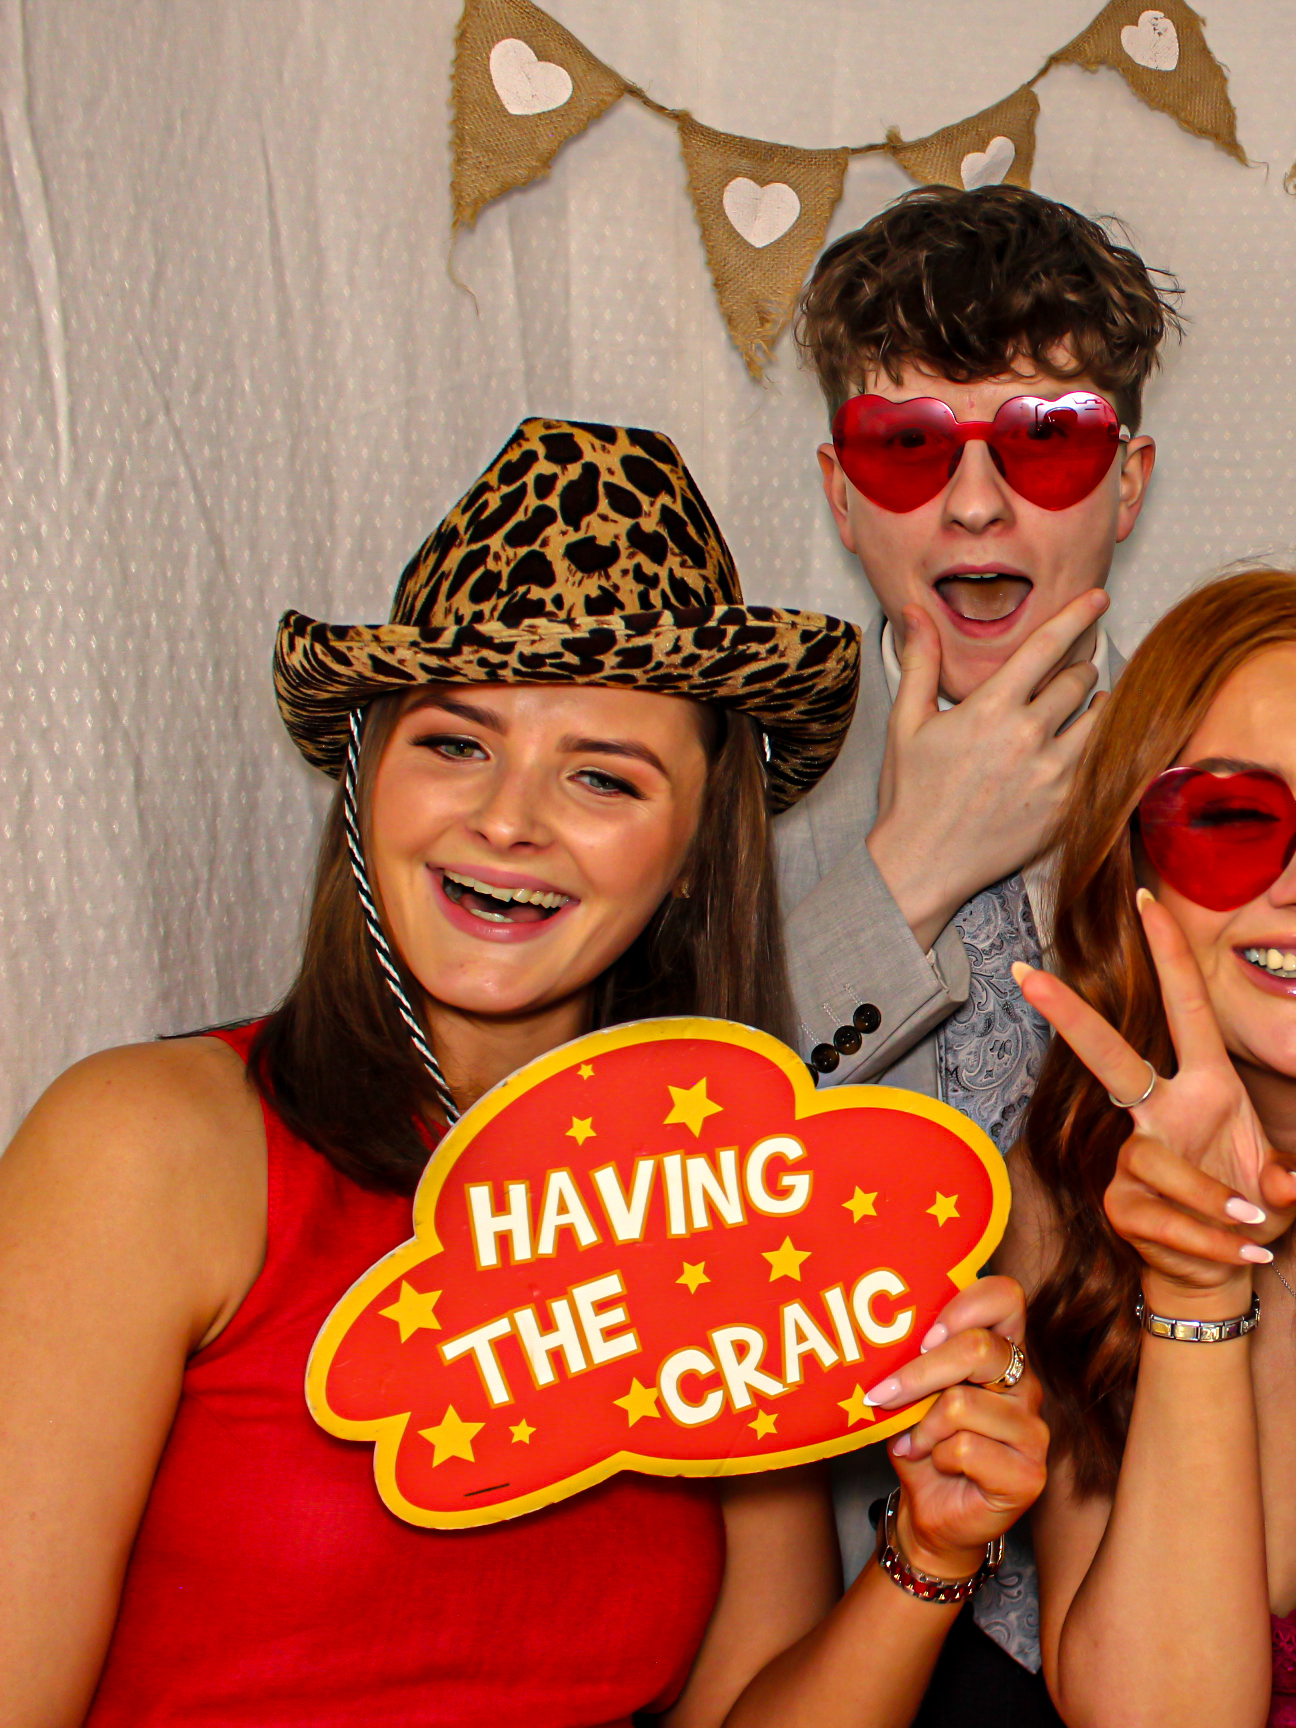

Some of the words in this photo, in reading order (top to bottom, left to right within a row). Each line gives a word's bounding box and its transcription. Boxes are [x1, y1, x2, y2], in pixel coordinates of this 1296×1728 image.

[467, 1136, 812, 1267] HAVING
[441, 1272, 638, 1406] THE
[659, 1269, 914, 1426] CRAIC
